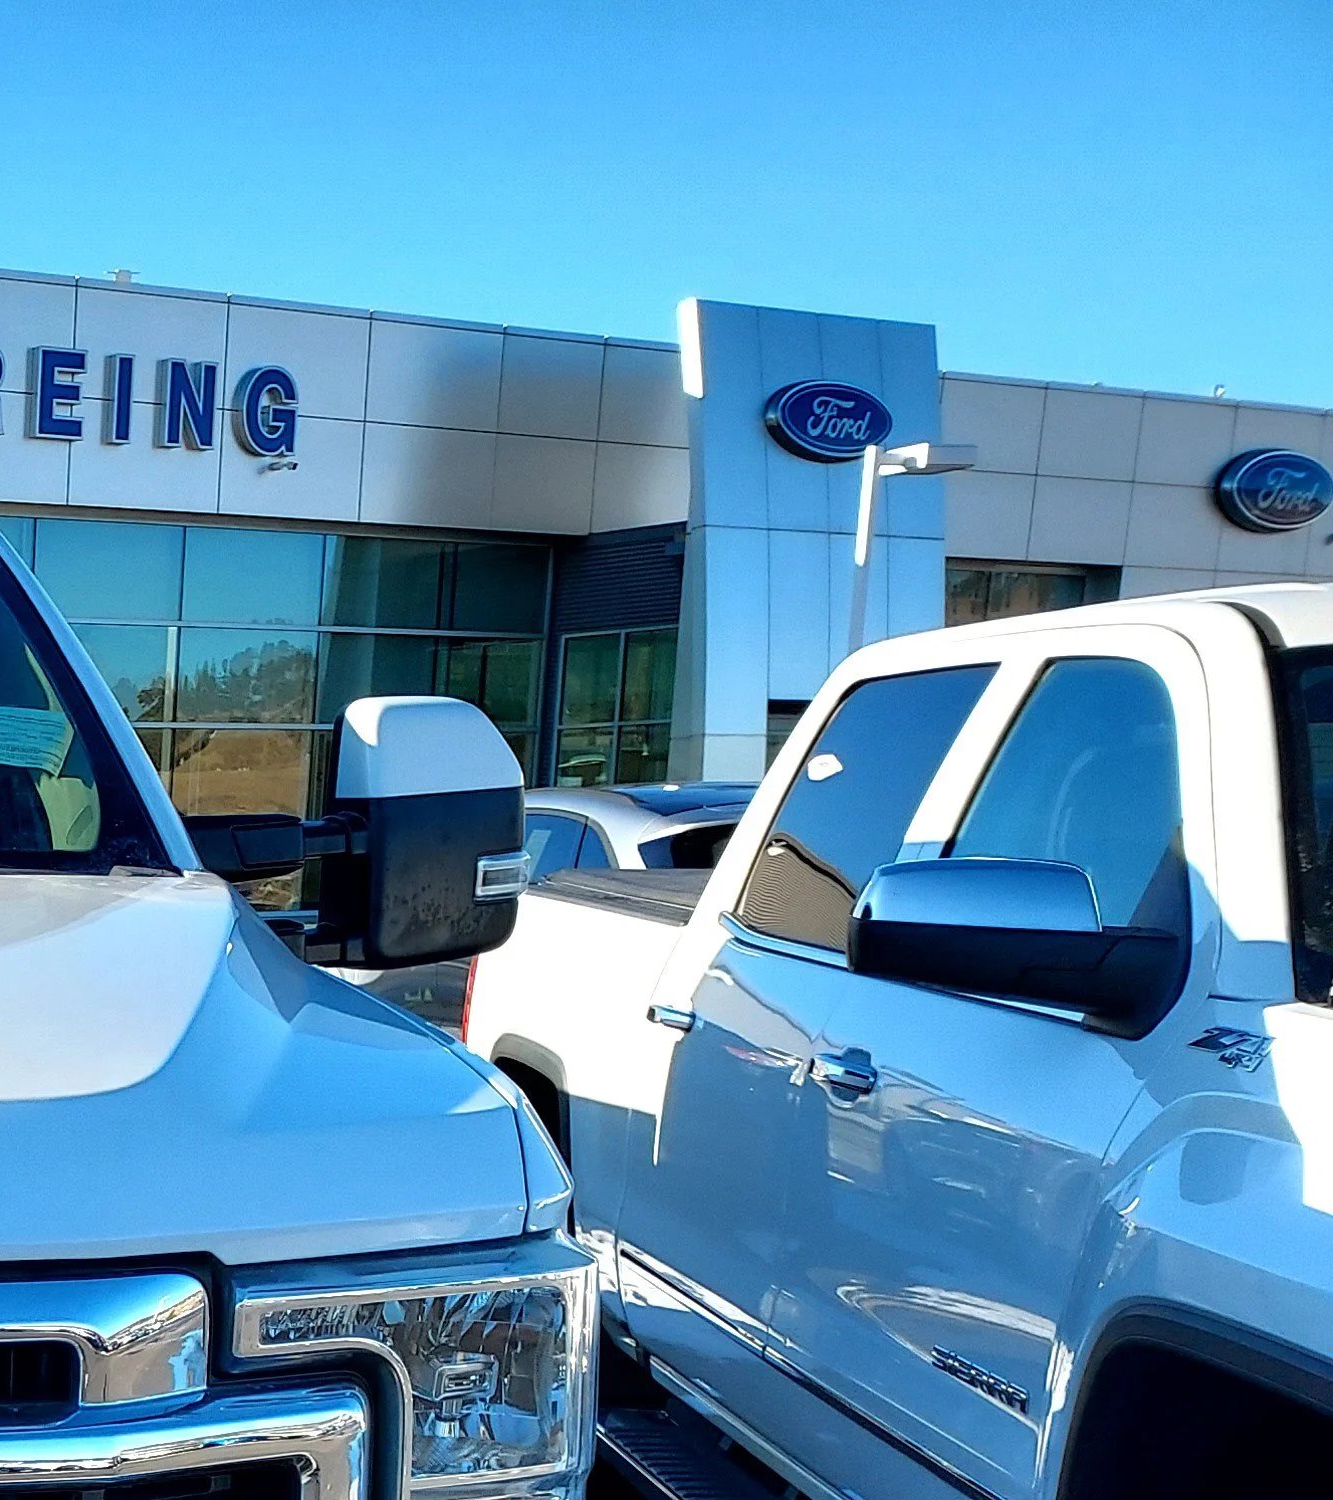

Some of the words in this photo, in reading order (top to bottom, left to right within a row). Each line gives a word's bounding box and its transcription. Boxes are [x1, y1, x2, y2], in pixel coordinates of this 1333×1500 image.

[806, 396, 872, 441] Ford
[1257, 467, 1320, 511] Ford
[931, 1344, 1030, 1414] SIERRA
